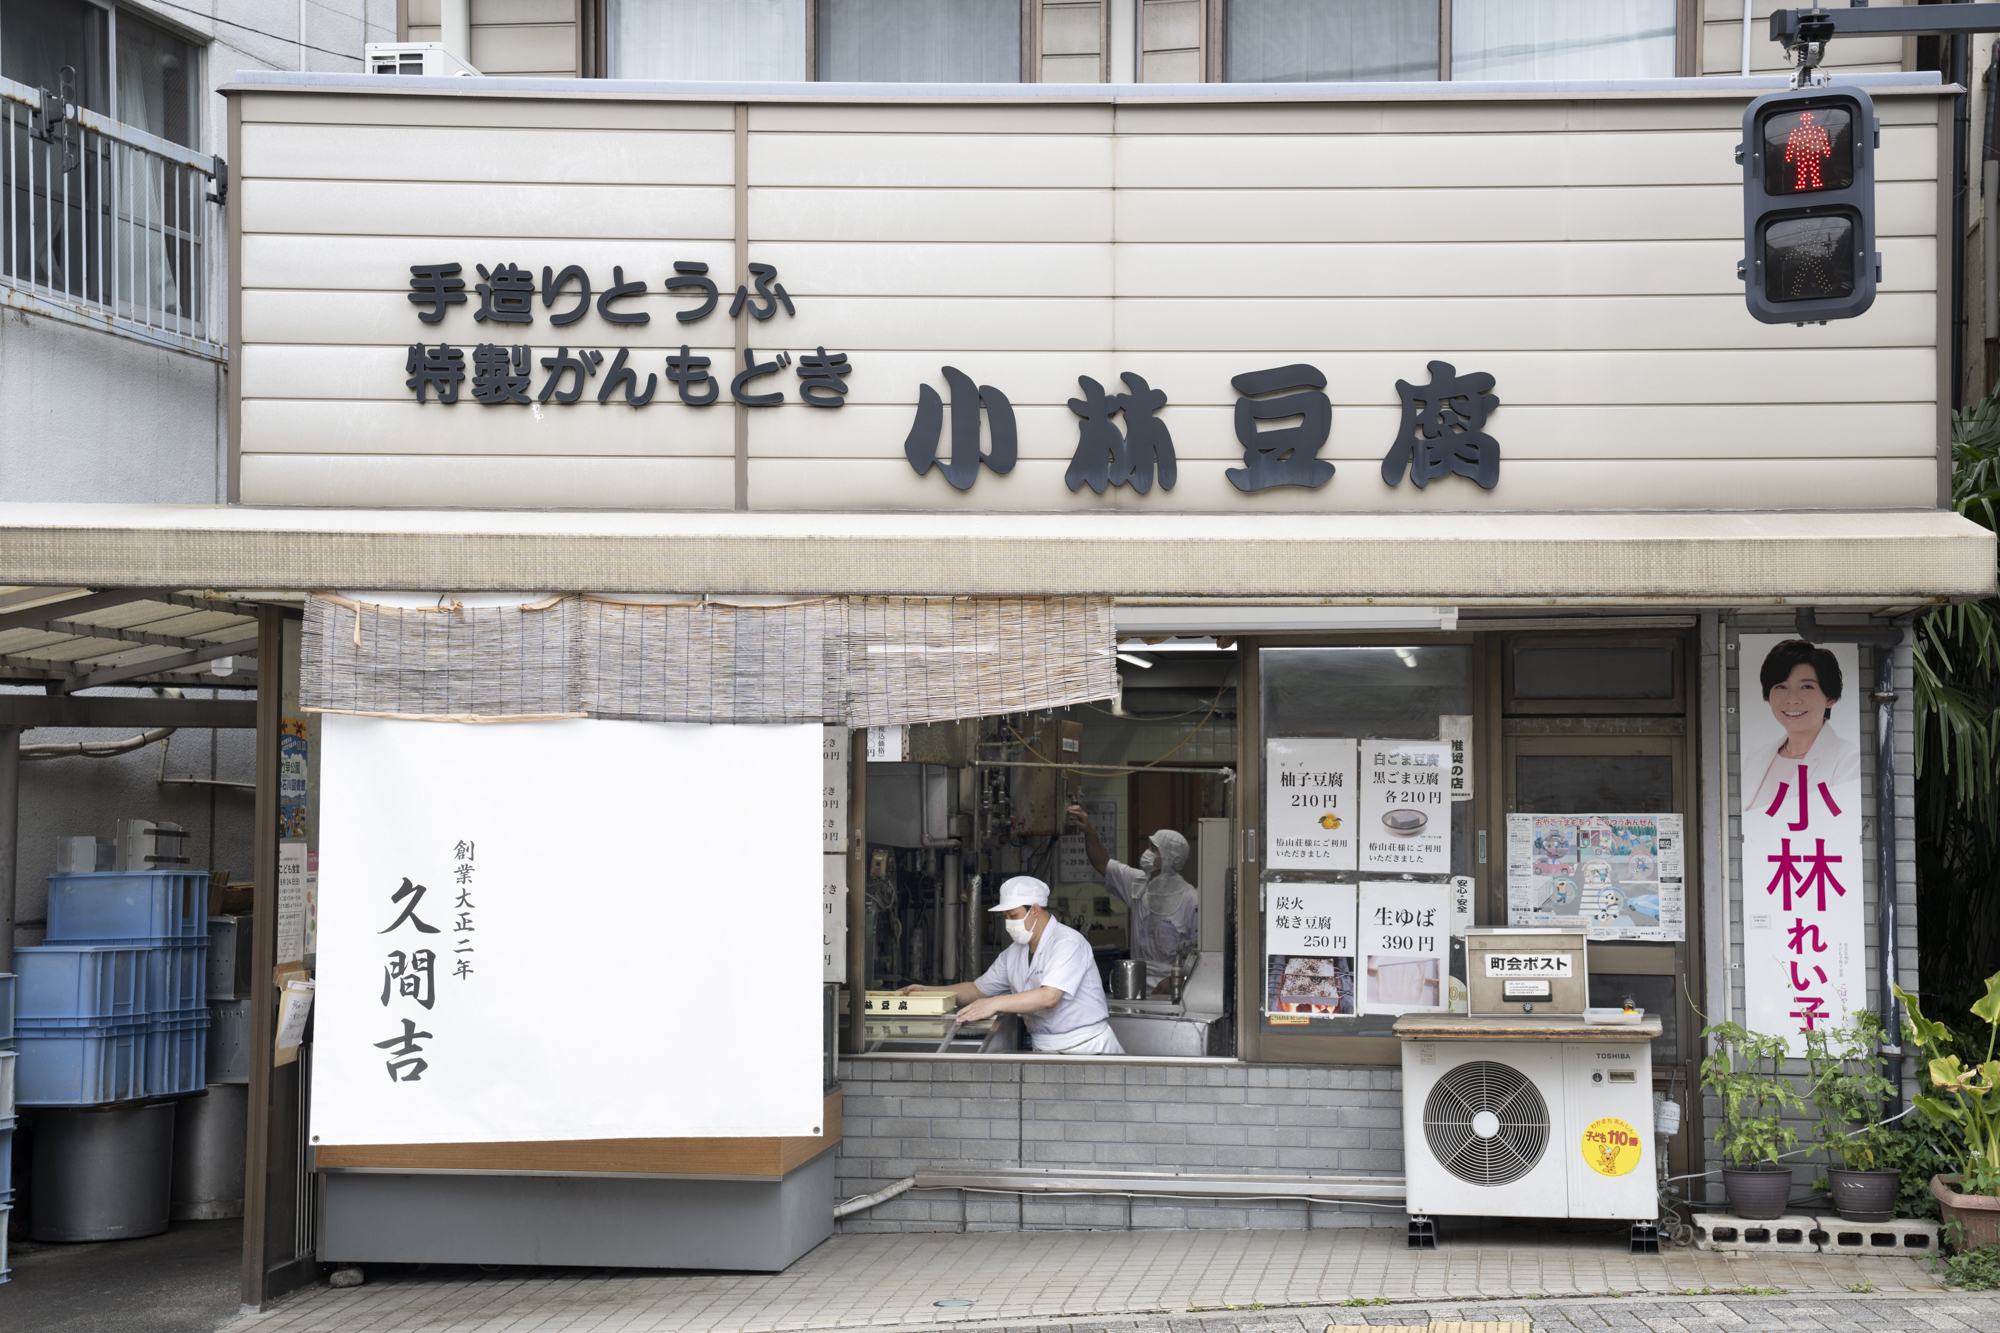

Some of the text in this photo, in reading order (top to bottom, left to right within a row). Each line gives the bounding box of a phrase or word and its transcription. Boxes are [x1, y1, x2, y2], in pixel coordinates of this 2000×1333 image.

[407, 260, 796, 325] 手造りとうふ
[405, 342, 852, 406] 特製がんもどき
[904, 360, 1501, 494] 小林豆腐
[1374, 752, 1440, 767] 白ごま豆腐
[281, 779, 306, 791] 石川図書館
[1280, 771, 1343, 788] 柚子豆腐
[1373, 771, 1440, 786] 黒ごま豆腐
[1291, 794, 1337, 808] 210円
[1385, 790, 1442, 804] 各210円
[1276, 838, 1348, 848] 椿山荘様にご利用
[1369, 842, 1442, 853] 椿山荘様にご利用
[1276, 850, 1331, 859] いただきました
[1369, 854, 1424, 864] いただきました
[1275, 897, 1304, 910] 炭火
[1456, 880, 1468, 914] 安心・安全
[1765, 764, 1847, 1032] 小林れい子
[452, 839, 476, 981] 創業大正二年
[1374, 906, 1437, 927] 生ゆば
[1275, 915, 1332, 930] 焼き豆腐
[1303, 935, 1347, 949] 250円
[1382, 935, 1434, 952] 390円
[1490, 957, 1568, 971] 町会ポスト
[372, 877, 442, 1083] 久間吉
[847, 1000, 908, 1010] 林豆腐
[1586, 1130, 1638, 1147] 子ども110番
